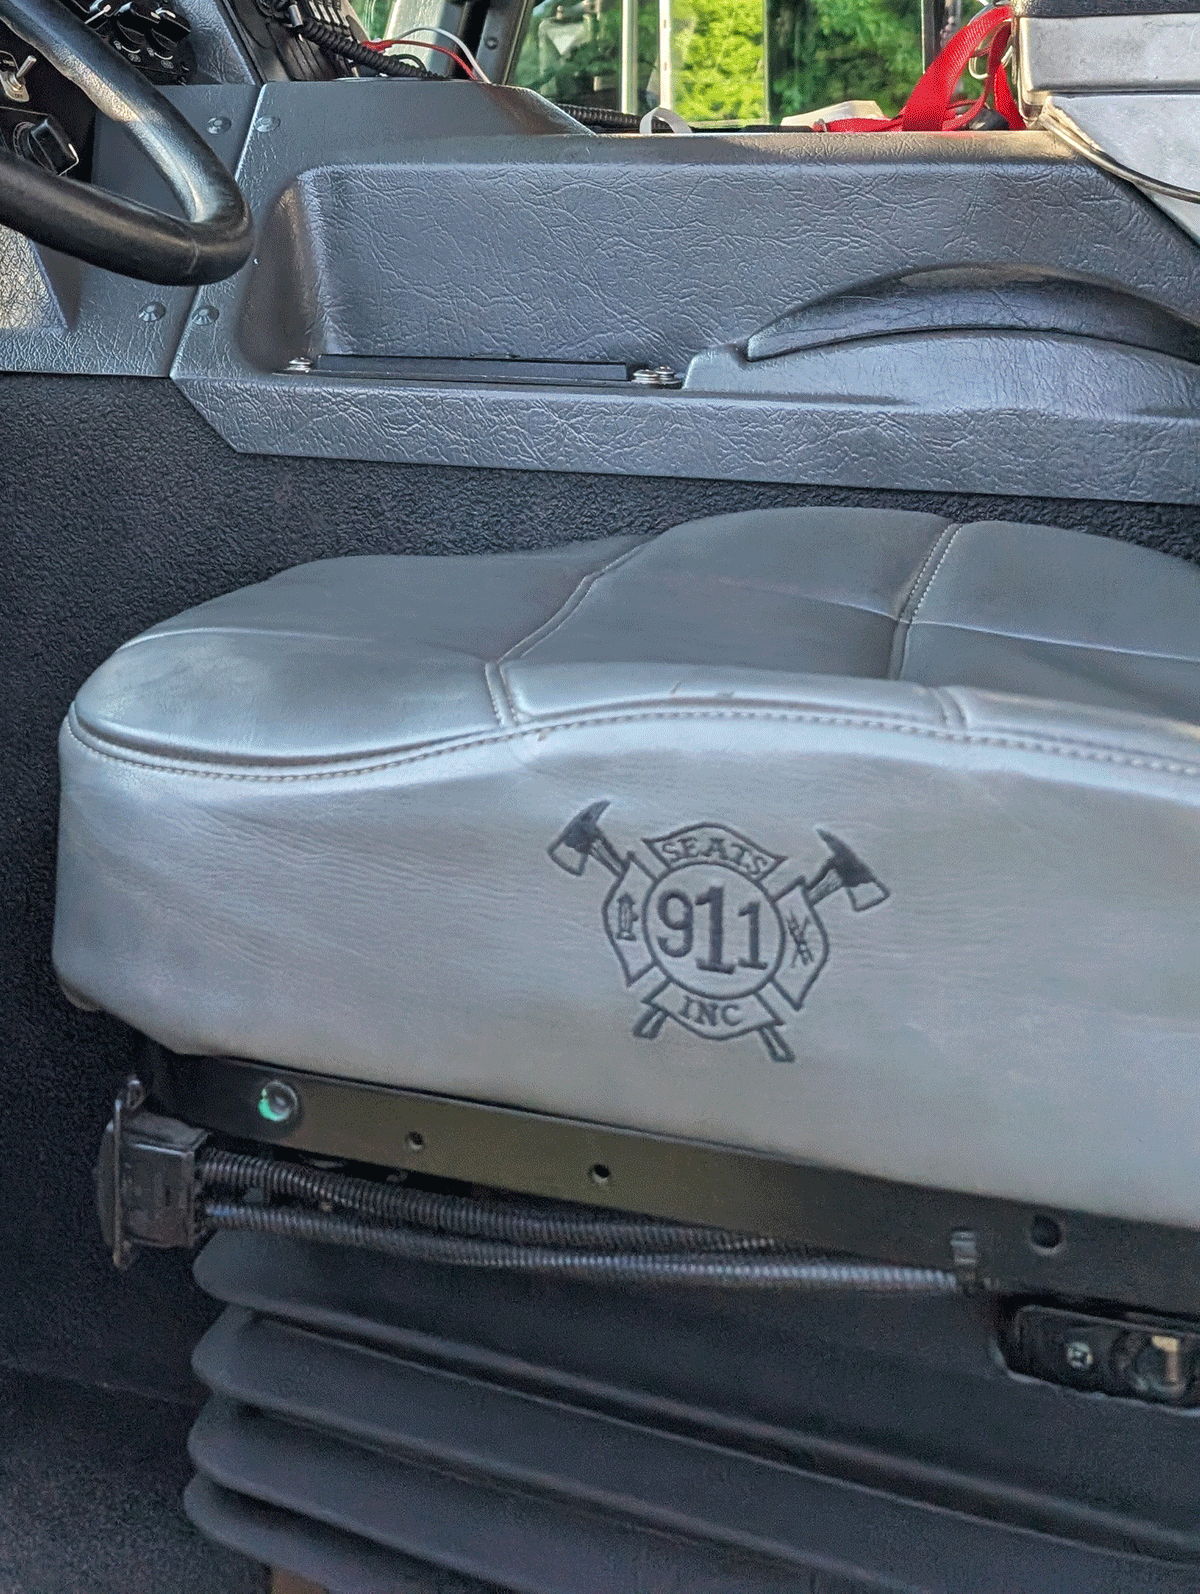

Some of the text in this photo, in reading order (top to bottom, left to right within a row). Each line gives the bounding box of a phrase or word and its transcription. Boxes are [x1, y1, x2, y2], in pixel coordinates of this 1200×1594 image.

[662, 837, 768, 875] SEATS
[657, 886, 769, 975] 911
[679, 995, 744, 1026] INC
